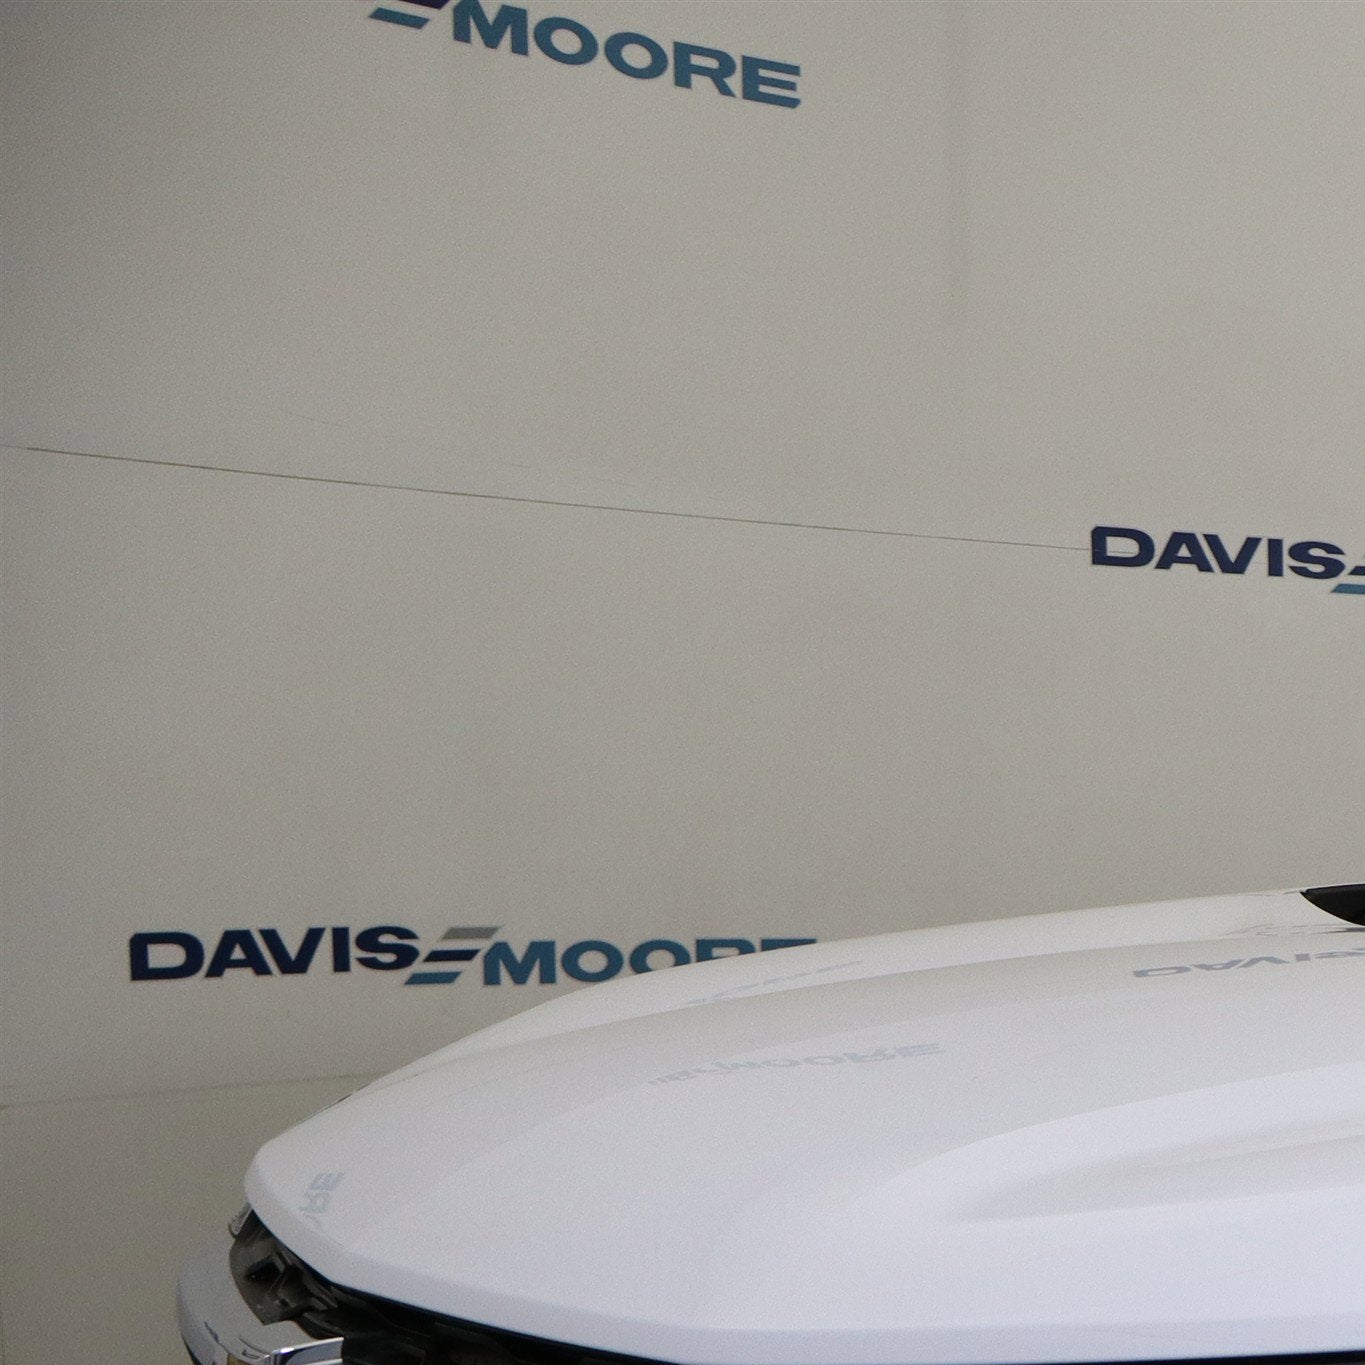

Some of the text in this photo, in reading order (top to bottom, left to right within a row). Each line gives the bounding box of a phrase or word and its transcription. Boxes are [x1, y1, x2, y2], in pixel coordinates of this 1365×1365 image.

[452, 0, 801, 109] MOORE
[1090, 526, 1347, 580] DAVIS
[129, 925, 816, 987] DAVIS MOO
